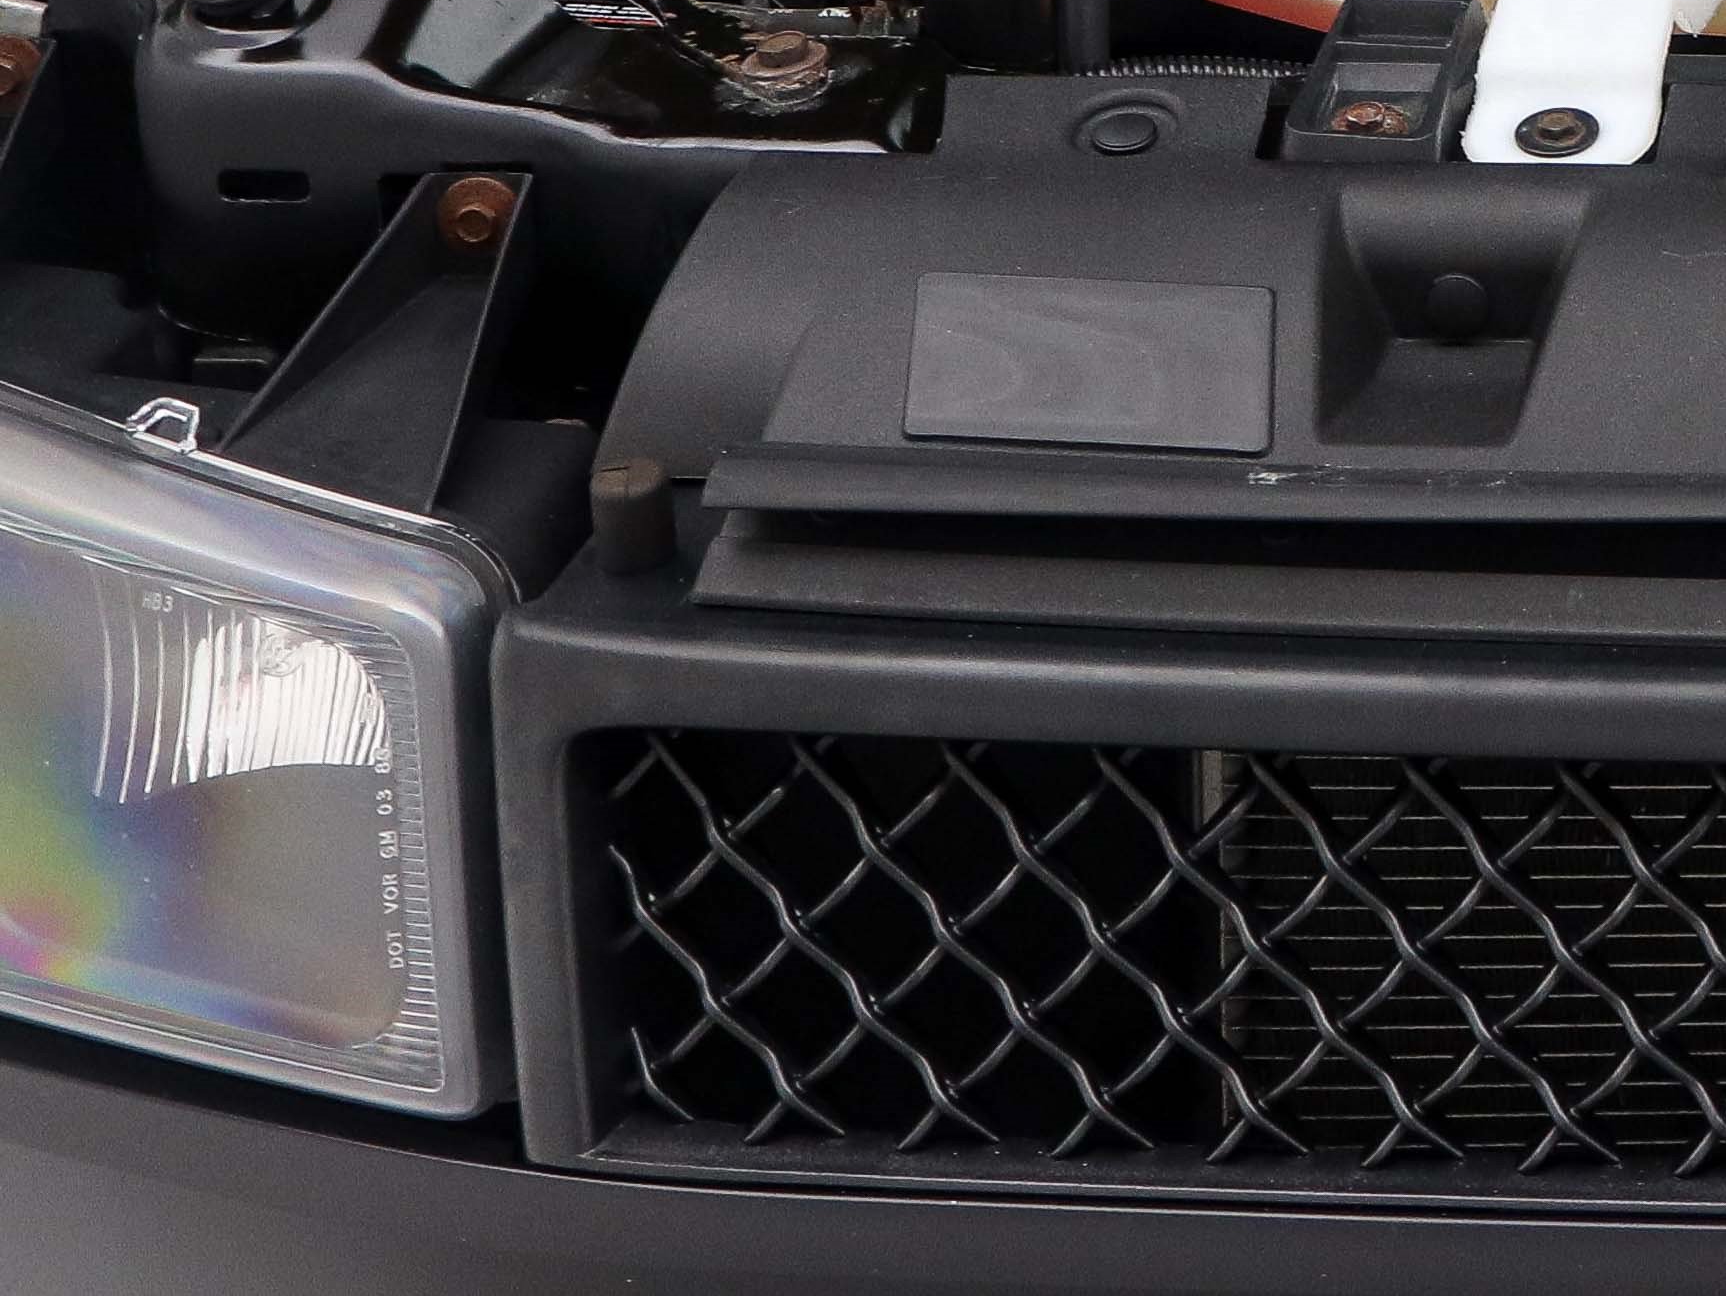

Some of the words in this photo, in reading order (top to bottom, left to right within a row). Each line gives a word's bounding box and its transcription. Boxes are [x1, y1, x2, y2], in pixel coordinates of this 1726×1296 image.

[375, 788, 393, 816] 03
[378, 830, 399, 859] GM
[382, 873, 399, 915] VOR
[387, 930, 404, 969] DOT
